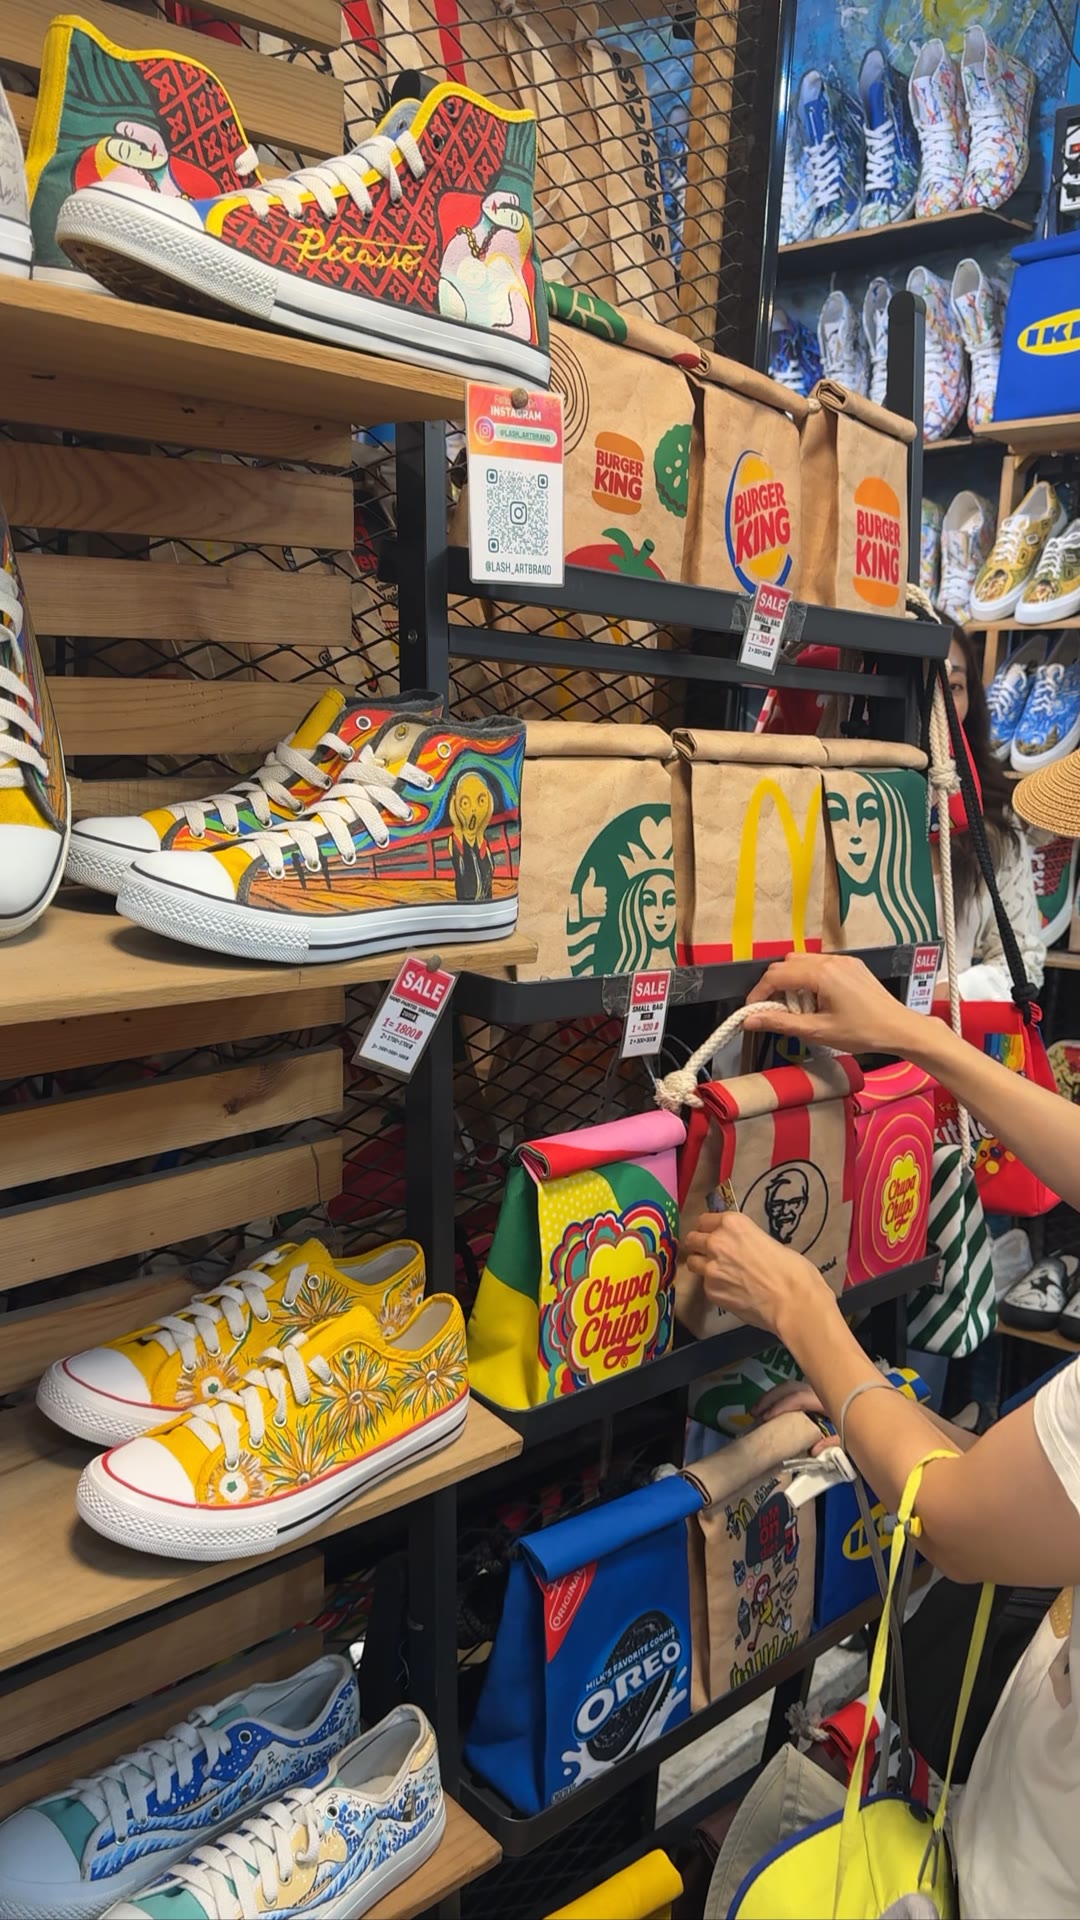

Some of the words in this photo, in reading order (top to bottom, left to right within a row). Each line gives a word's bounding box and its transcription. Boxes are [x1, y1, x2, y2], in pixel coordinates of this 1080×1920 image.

[490, 405, 541, 421] INSTAGRAM
[499, 429, 551, 443] @LASH_ARTBRAND
[596, 449, 643, 478] BURGER
[594, 467, 643, 501] KING
[734, 482, 786, 525] BURGER
[735, 507, 791, 566] KING
[856, 509, 900, 547] BURGER
[485, 560, 552, 576] @LASH_ARTBRAND
[855, 538, 899, 585] KING
[759, 592, 786, 613] SALE
[916, 955, 937, 968] SALE
[402, 970, 446, 1003] SALE
[635, 980, 666, 997] SALE
[632, 1004, 651, 1013] SMALL
[652, 1002, 664, 1011] BAG
[889, 1175, 917, 1201] Chupa
[885, 1195, 914, 1232] Chups
[584, 1269, 654, 1316] Chupa
[580, 1304, 650, 1369] Chups
[552, 1570, 583, 1627] ORIGINAL
[585, 1668, 613, 1692] MILK'S
[612, 1643, 649, 1674] FAVORITE
[649, 1626, 676, 1648] COOKIE
[576, 1641, 682, 1734] OREO
